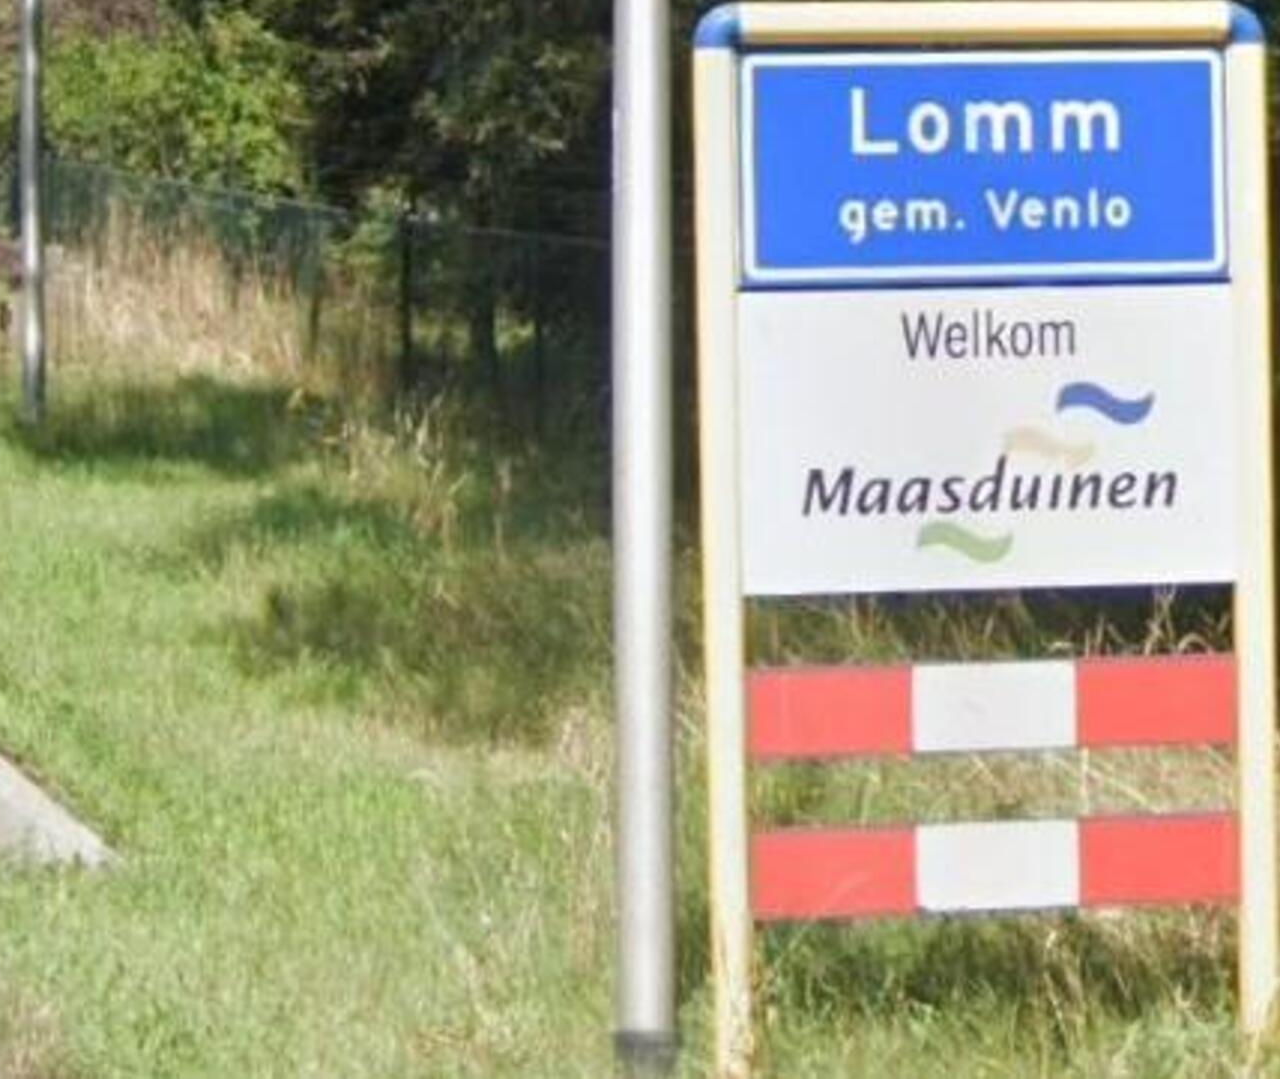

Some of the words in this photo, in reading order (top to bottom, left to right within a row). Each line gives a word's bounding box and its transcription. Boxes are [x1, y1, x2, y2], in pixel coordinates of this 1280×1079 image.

[849, 87, 1120, 155] Lomm
[839, 196, 966, 243] gem.
[985, 188, 1132, 229] Venlo
[901, 310, 1076, 361] Welkom
[801, 454, 1178, 517] Maasduinen
